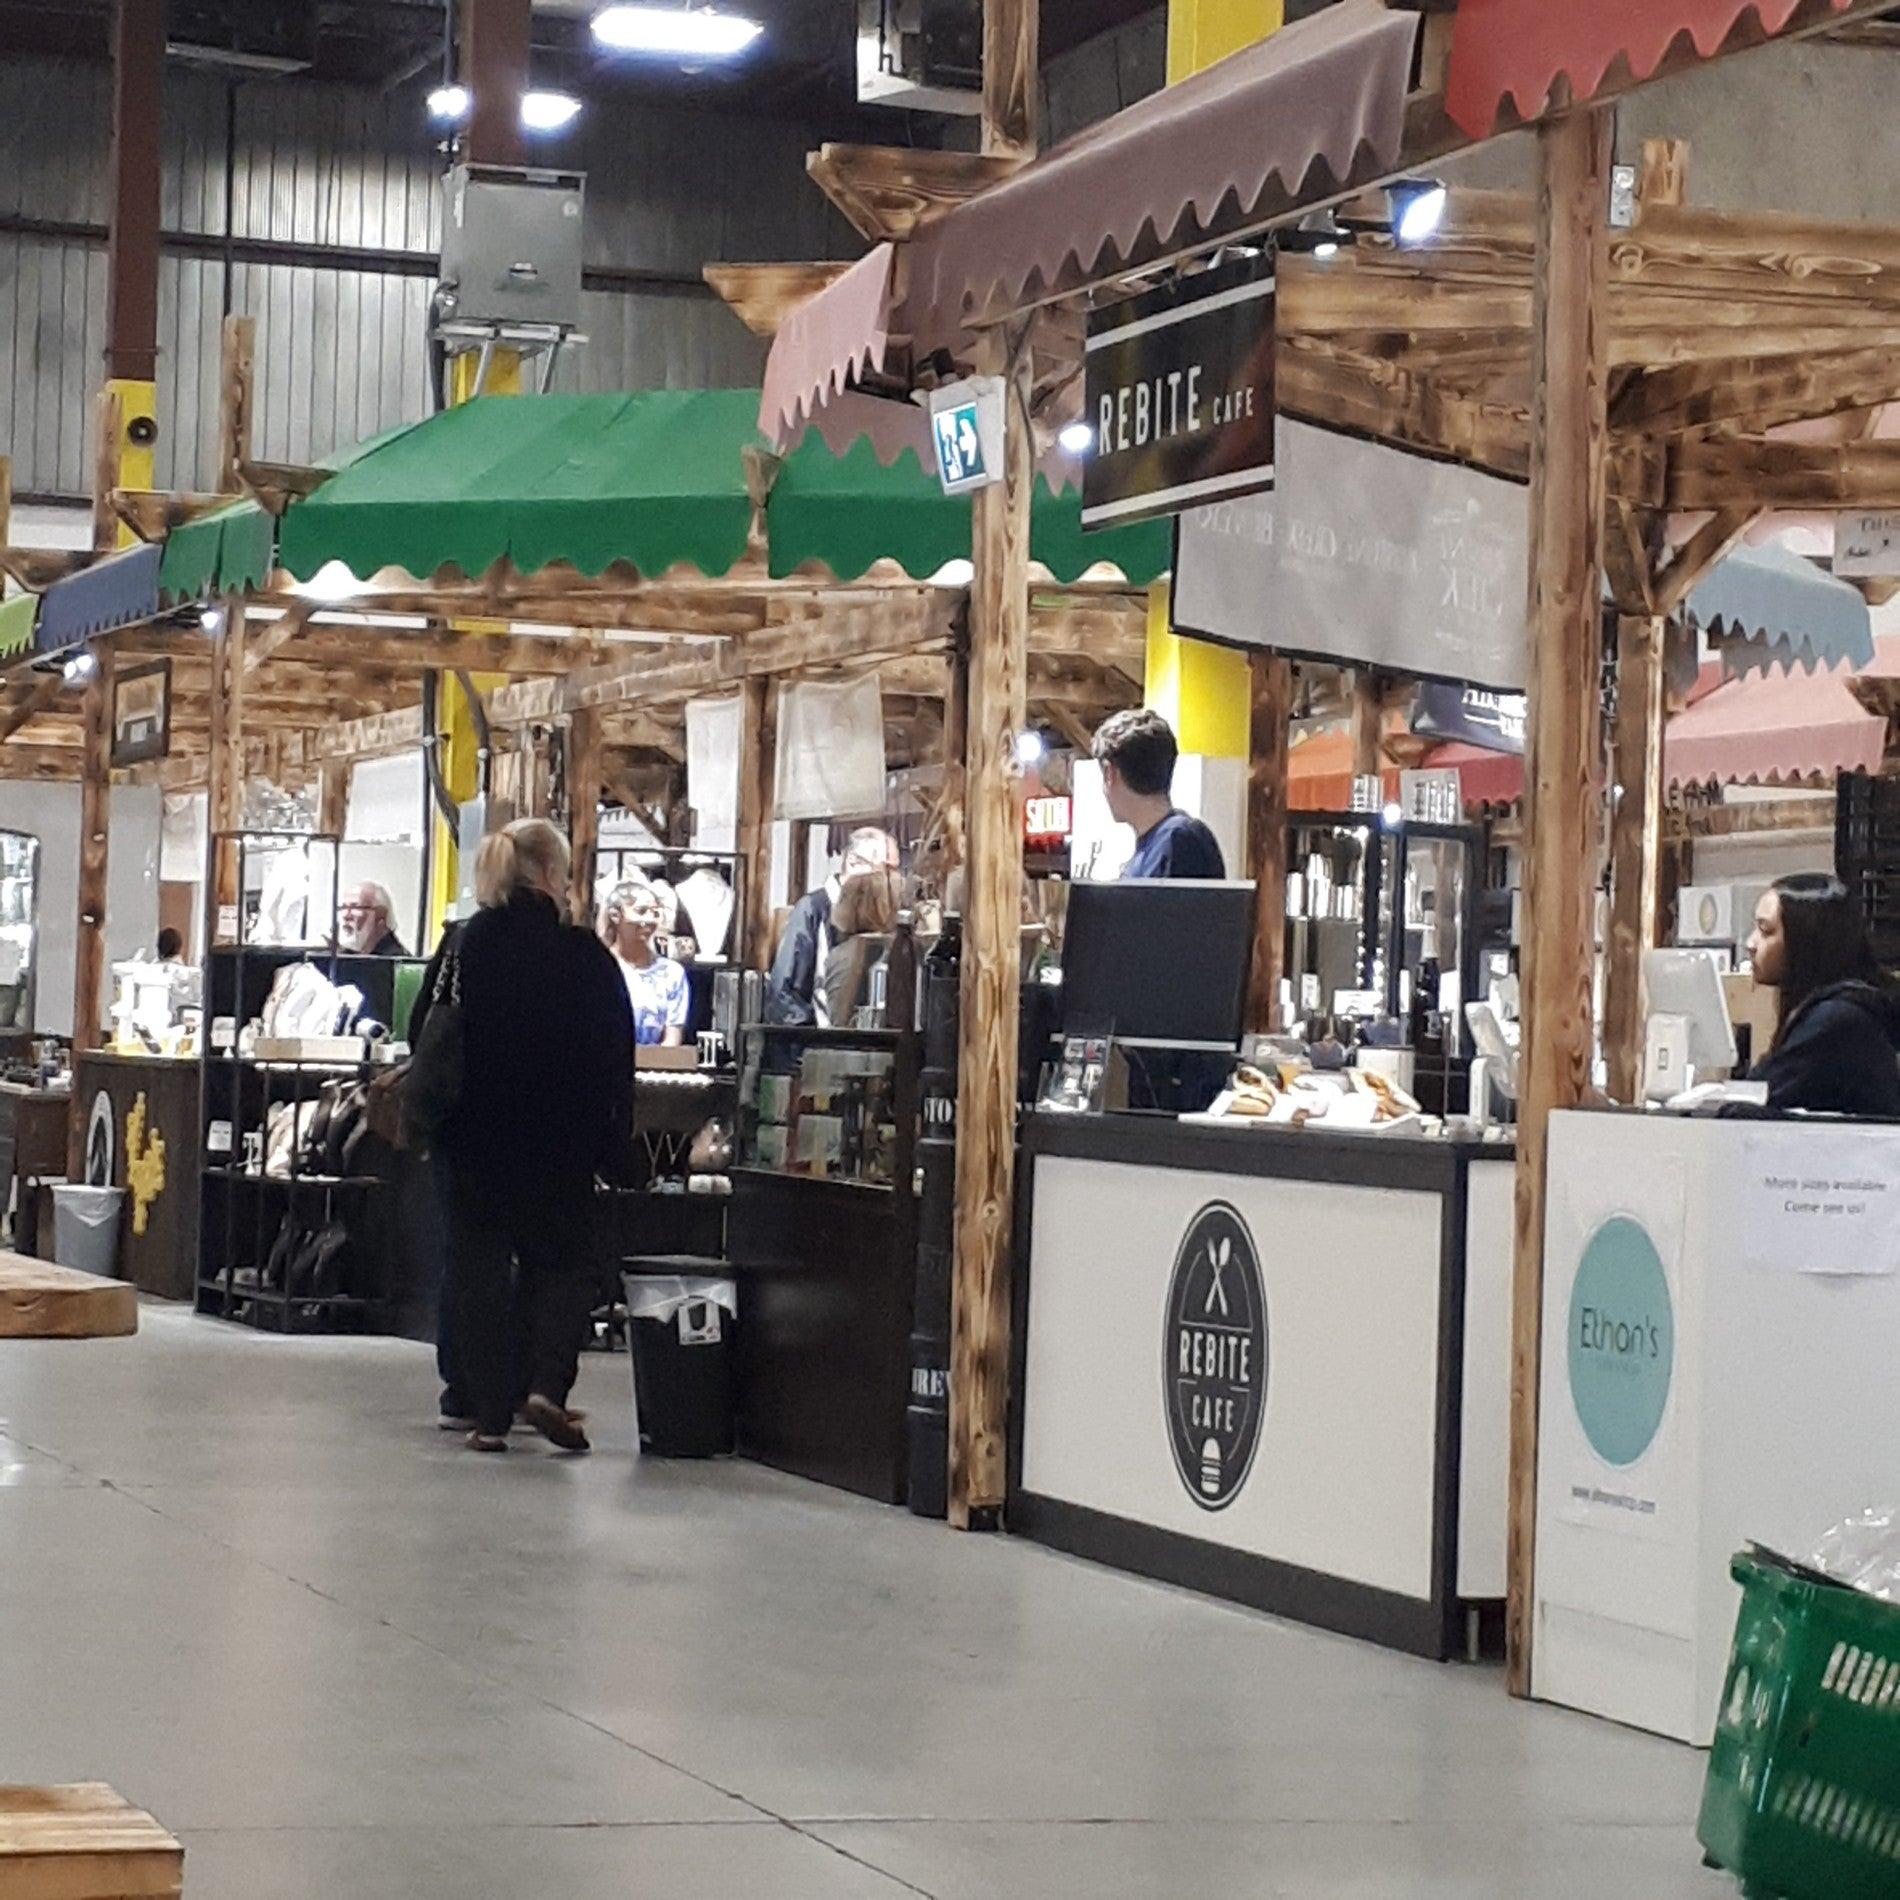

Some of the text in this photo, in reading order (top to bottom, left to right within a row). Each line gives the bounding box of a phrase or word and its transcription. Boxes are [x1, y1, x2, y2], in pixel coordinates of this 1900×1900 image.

[1098, 365, 1254, 457] REBITE CAFE
[1179, 1329, 1250, 1383] REBITE
[1192, 1394, 1234, 1433] CAFE
